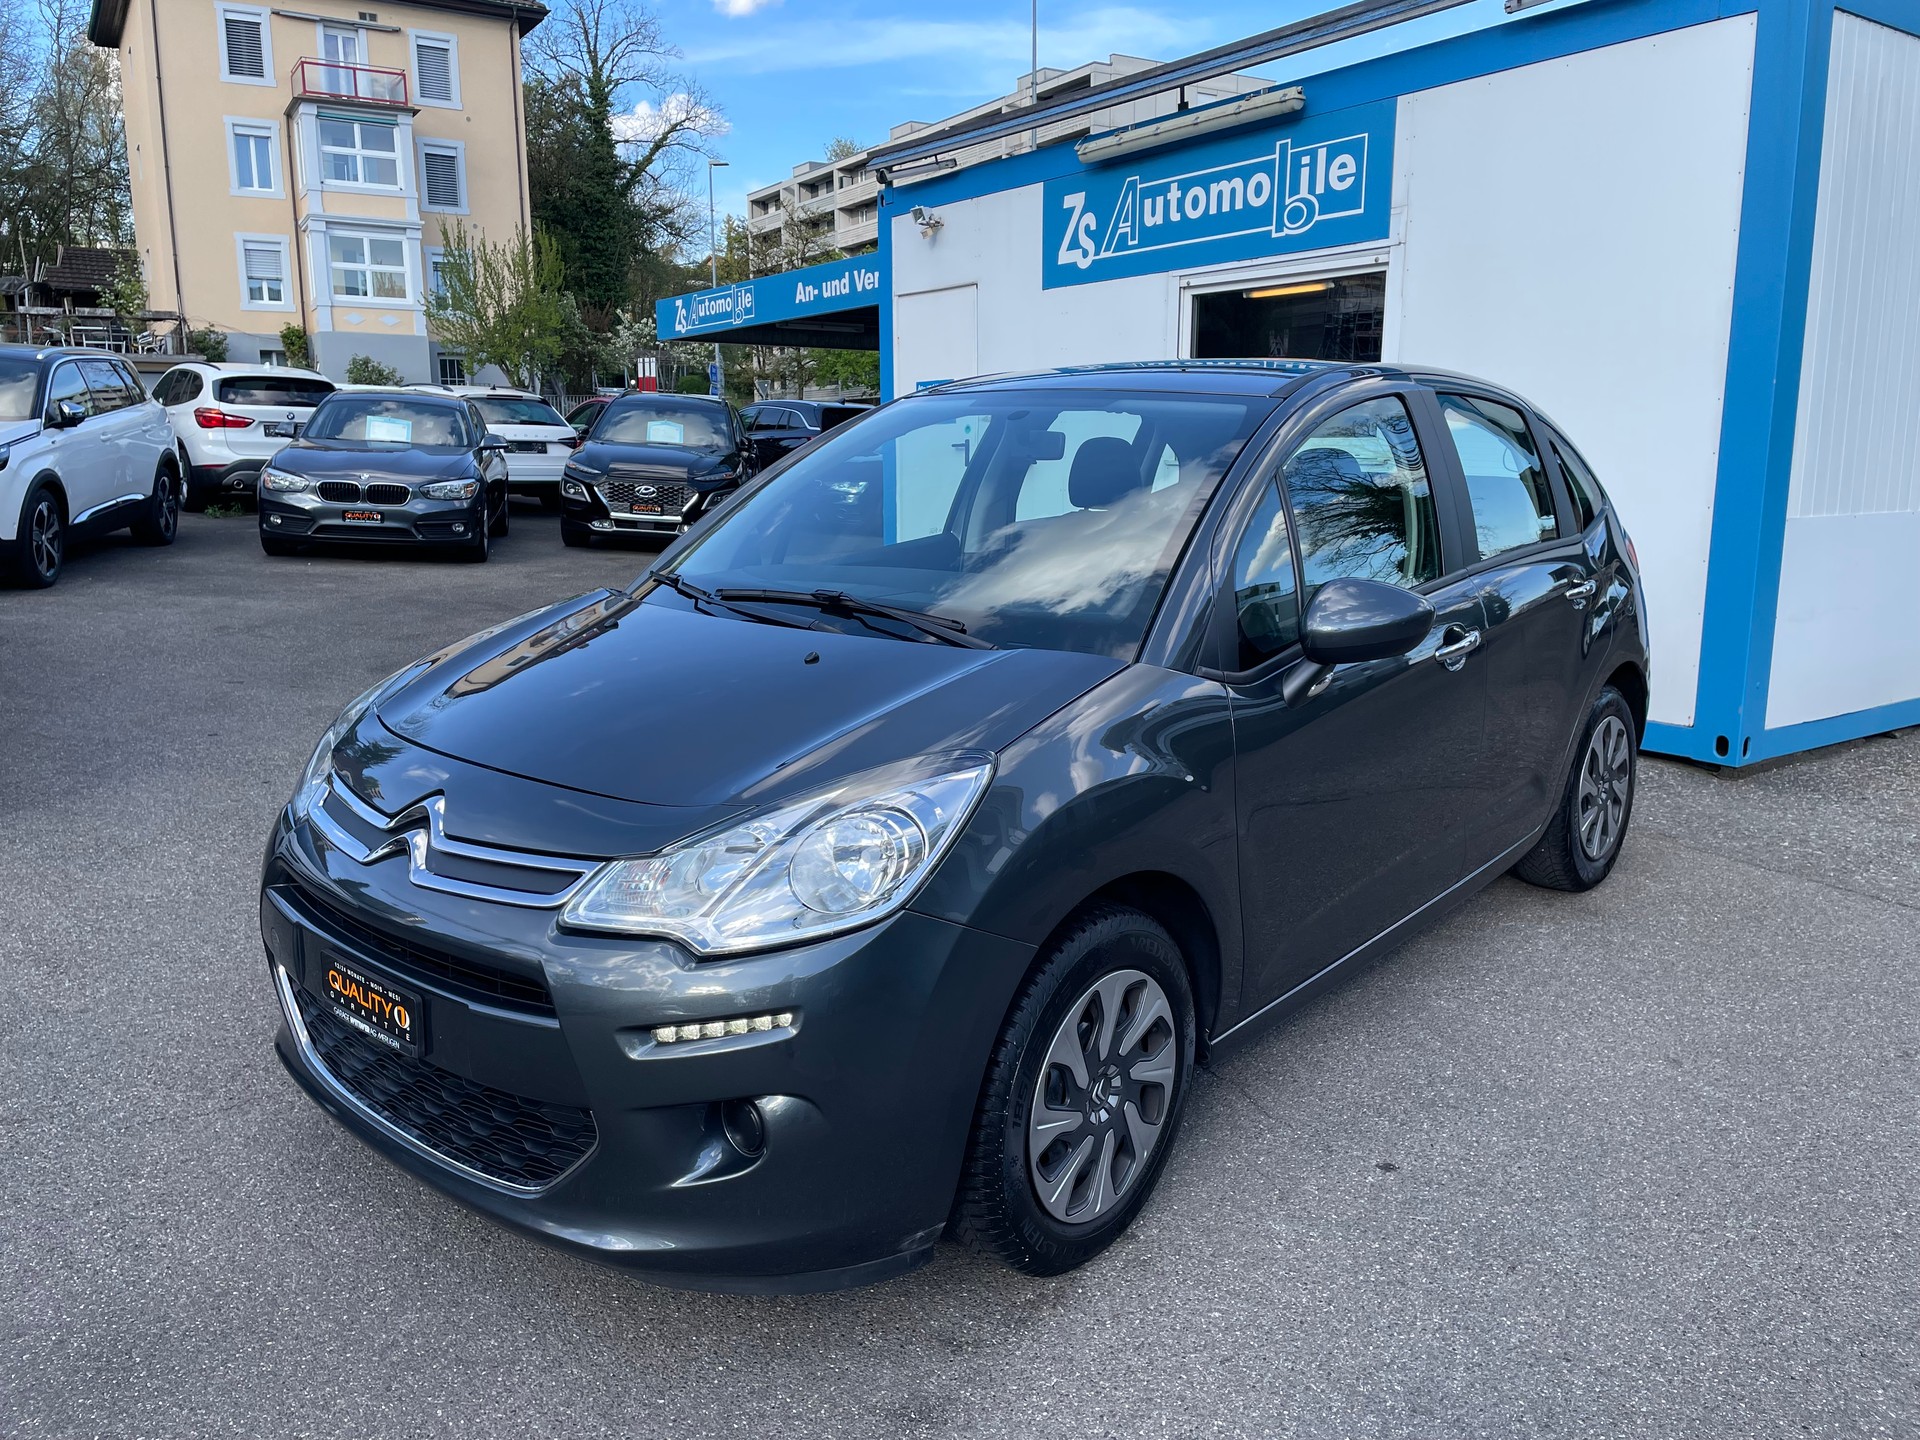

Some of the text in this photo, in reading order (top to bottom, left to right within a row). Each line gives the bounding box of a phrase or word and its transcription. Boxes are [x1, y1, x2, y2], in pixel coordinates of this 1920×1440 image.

[1057, 138, 1357, 270] Zs Automobile
[674, 284, 752, 334] Zs Automobile
[795, 282, 819, 304] An-
[822, 271, 850, 299] und
[347, 968, 365, 984] MONATE
[370, 981, 383, 993] MOIS
[329, 990, 411, 1042] GARANTIE
